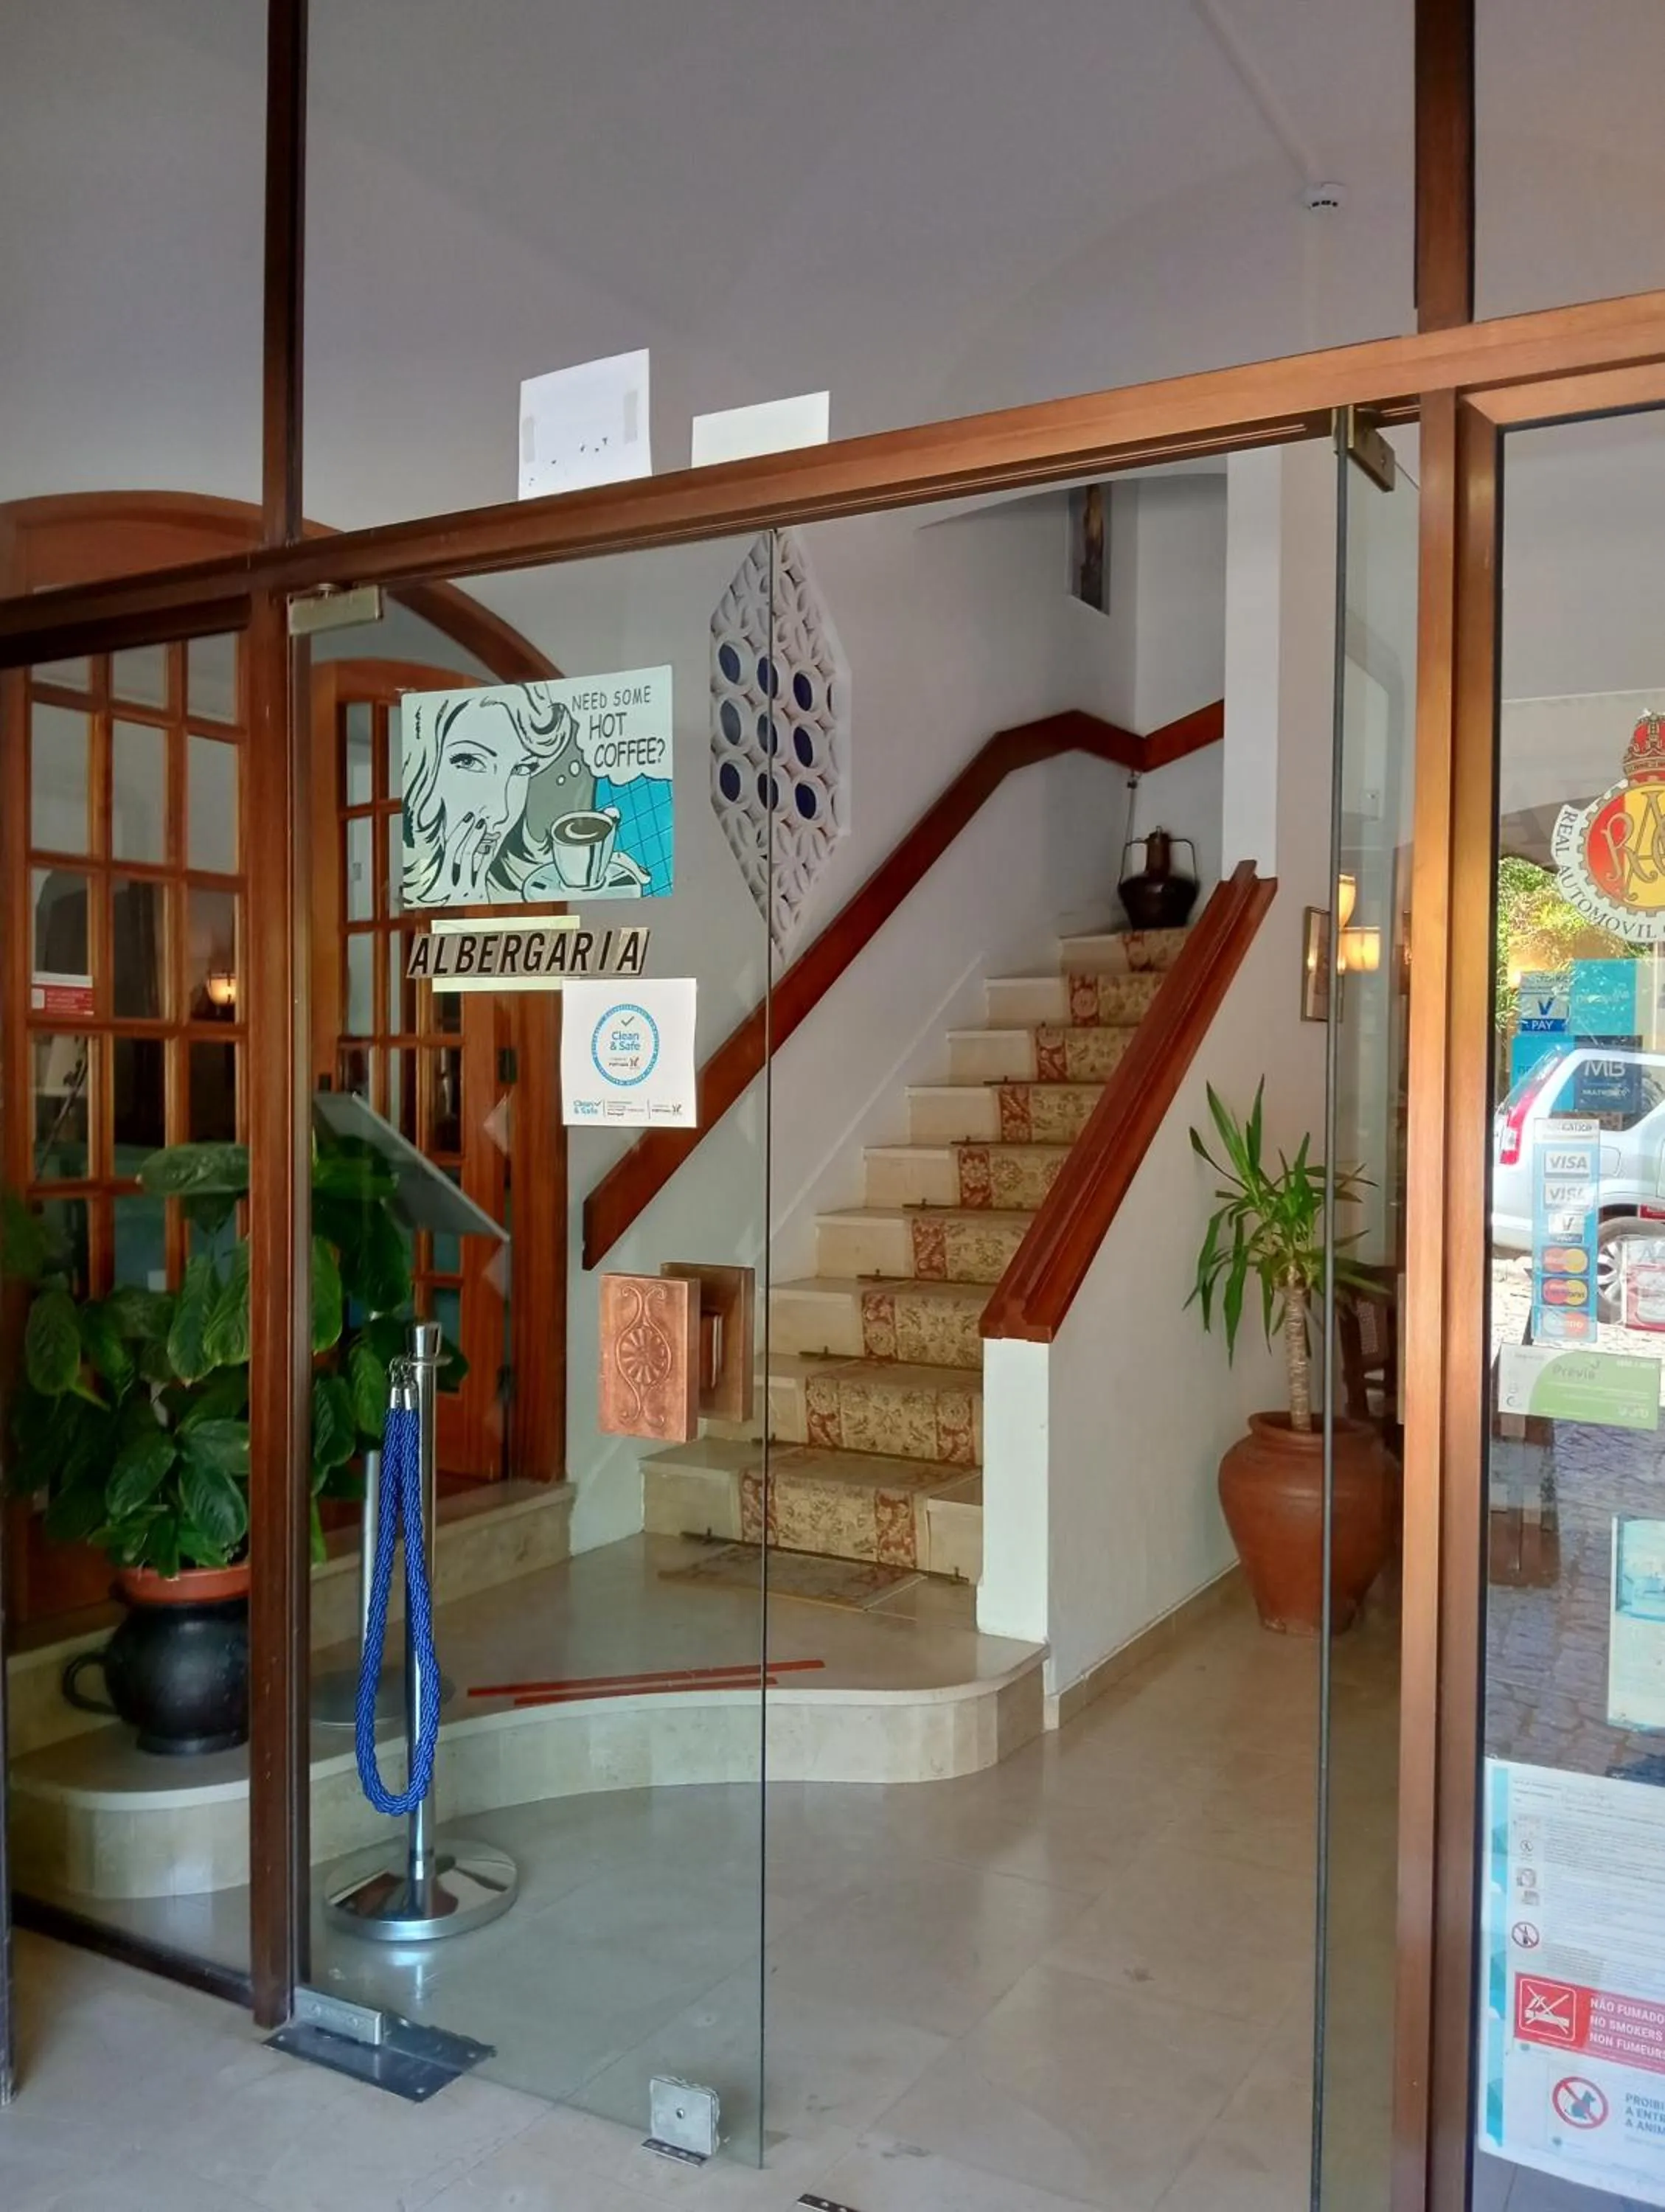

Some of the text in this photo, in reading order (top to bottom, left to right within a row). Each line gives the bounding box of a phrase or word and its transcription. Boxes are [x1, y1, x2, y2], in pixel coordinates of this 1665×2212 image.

[571, 686, 651, 712] NEED SOME
[589, 712, 628, 740] HOT
[594, 737, 666, 768] COFFEE?
[1555, 810, 1579, 858] REAL
[1558, 864, 1658, 939] AUTOMOVIL
[409, 930, 640, 975] ALBERGARIA
[611, 1030, 639, 1040] Clean
[1531, 1020, 1554, 1031] PAY
[619, 1040, 641, 1051] Safe
[1585, 1060, 1626, 1077] MB
[1548, 1155, 1588, 1169] VISA
[1589, 2032, 1613, 2048] NON
[1590, 2014, 1664, 2042] NO SMOKERS
